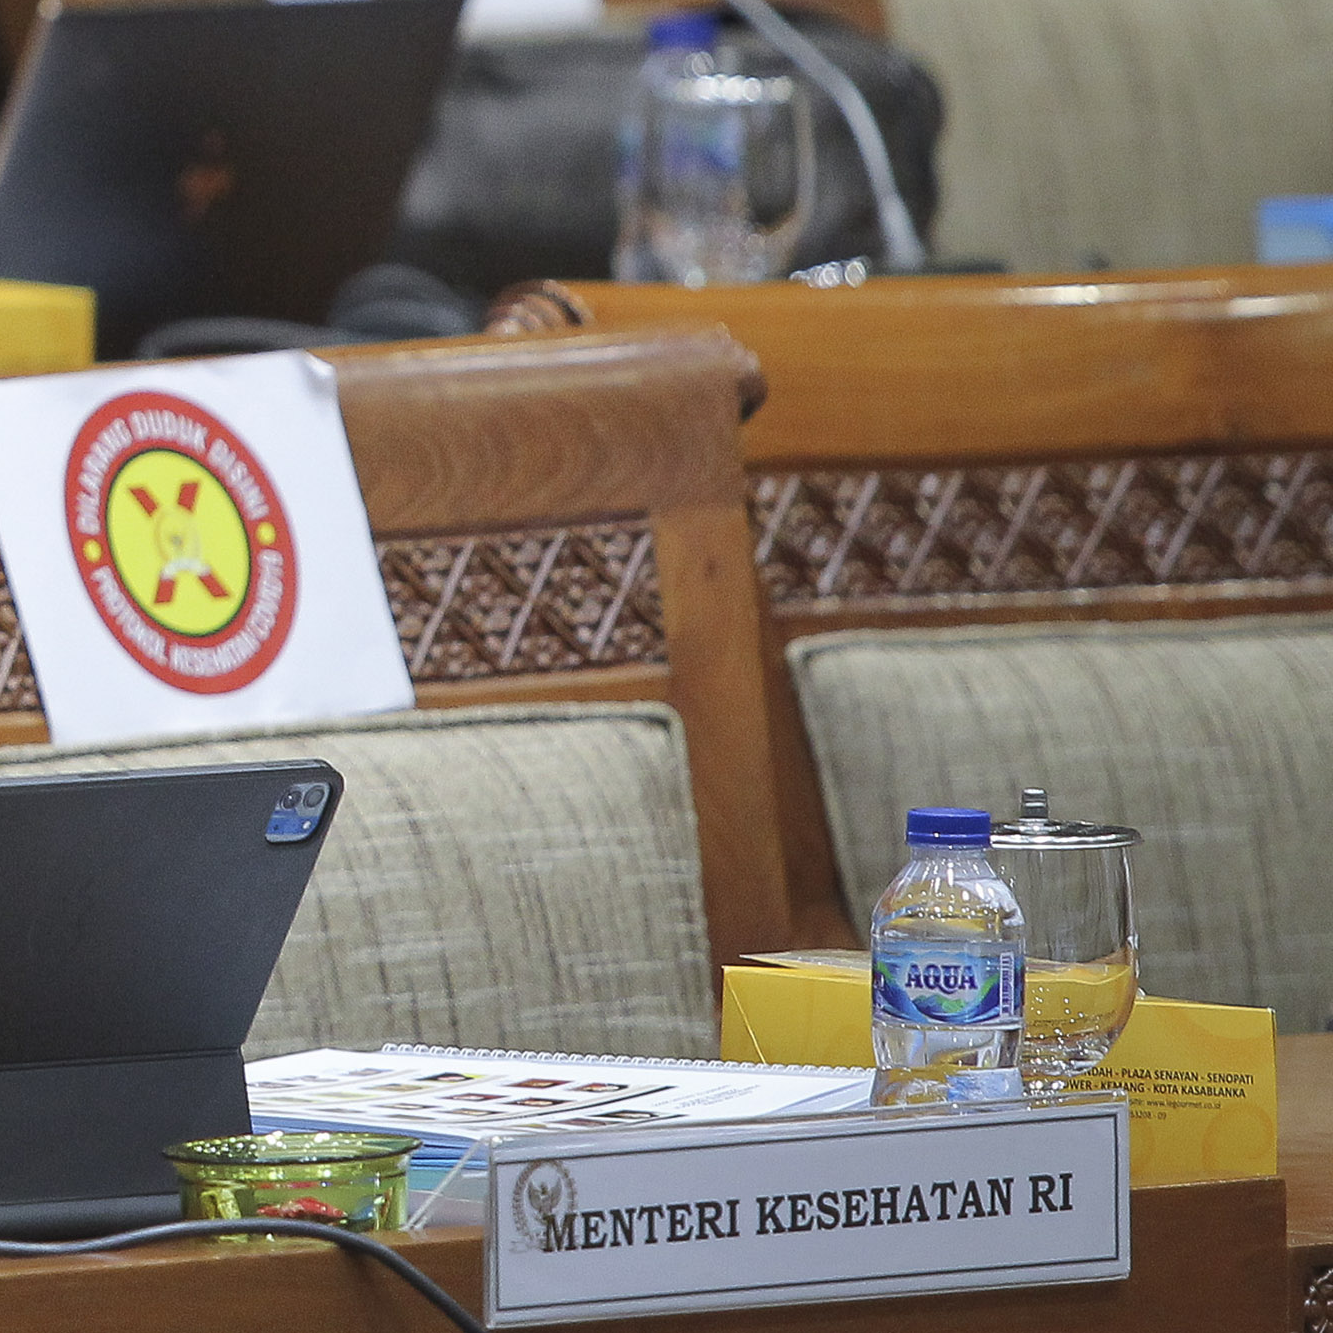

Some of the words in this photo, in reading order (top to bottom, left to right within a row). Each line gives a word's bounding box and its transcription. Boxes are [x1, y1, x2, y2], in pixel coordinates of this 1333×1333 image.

[132, 410, 209, 453] DUDUK
[905, 963, 978, 995] AQUA
[1084, 1067, 1113, 1078] NDAH
[1121, 1068, 1152, 1080] PLAZA
[1154, 1069, 1199, 1082] SENAYAN
[1207, 1072, 1254, 1085] SENOPATI
[1153, 1084, 1179, 1094] KOTA
[1181, 1086, 1246, 1098] KASABLANKA
[542, 1199, 740, 1253] MENTERI
[755, 1177, 1014, 1235] KESEHATAN
[1028, 1172, 1073, 1214] RI
